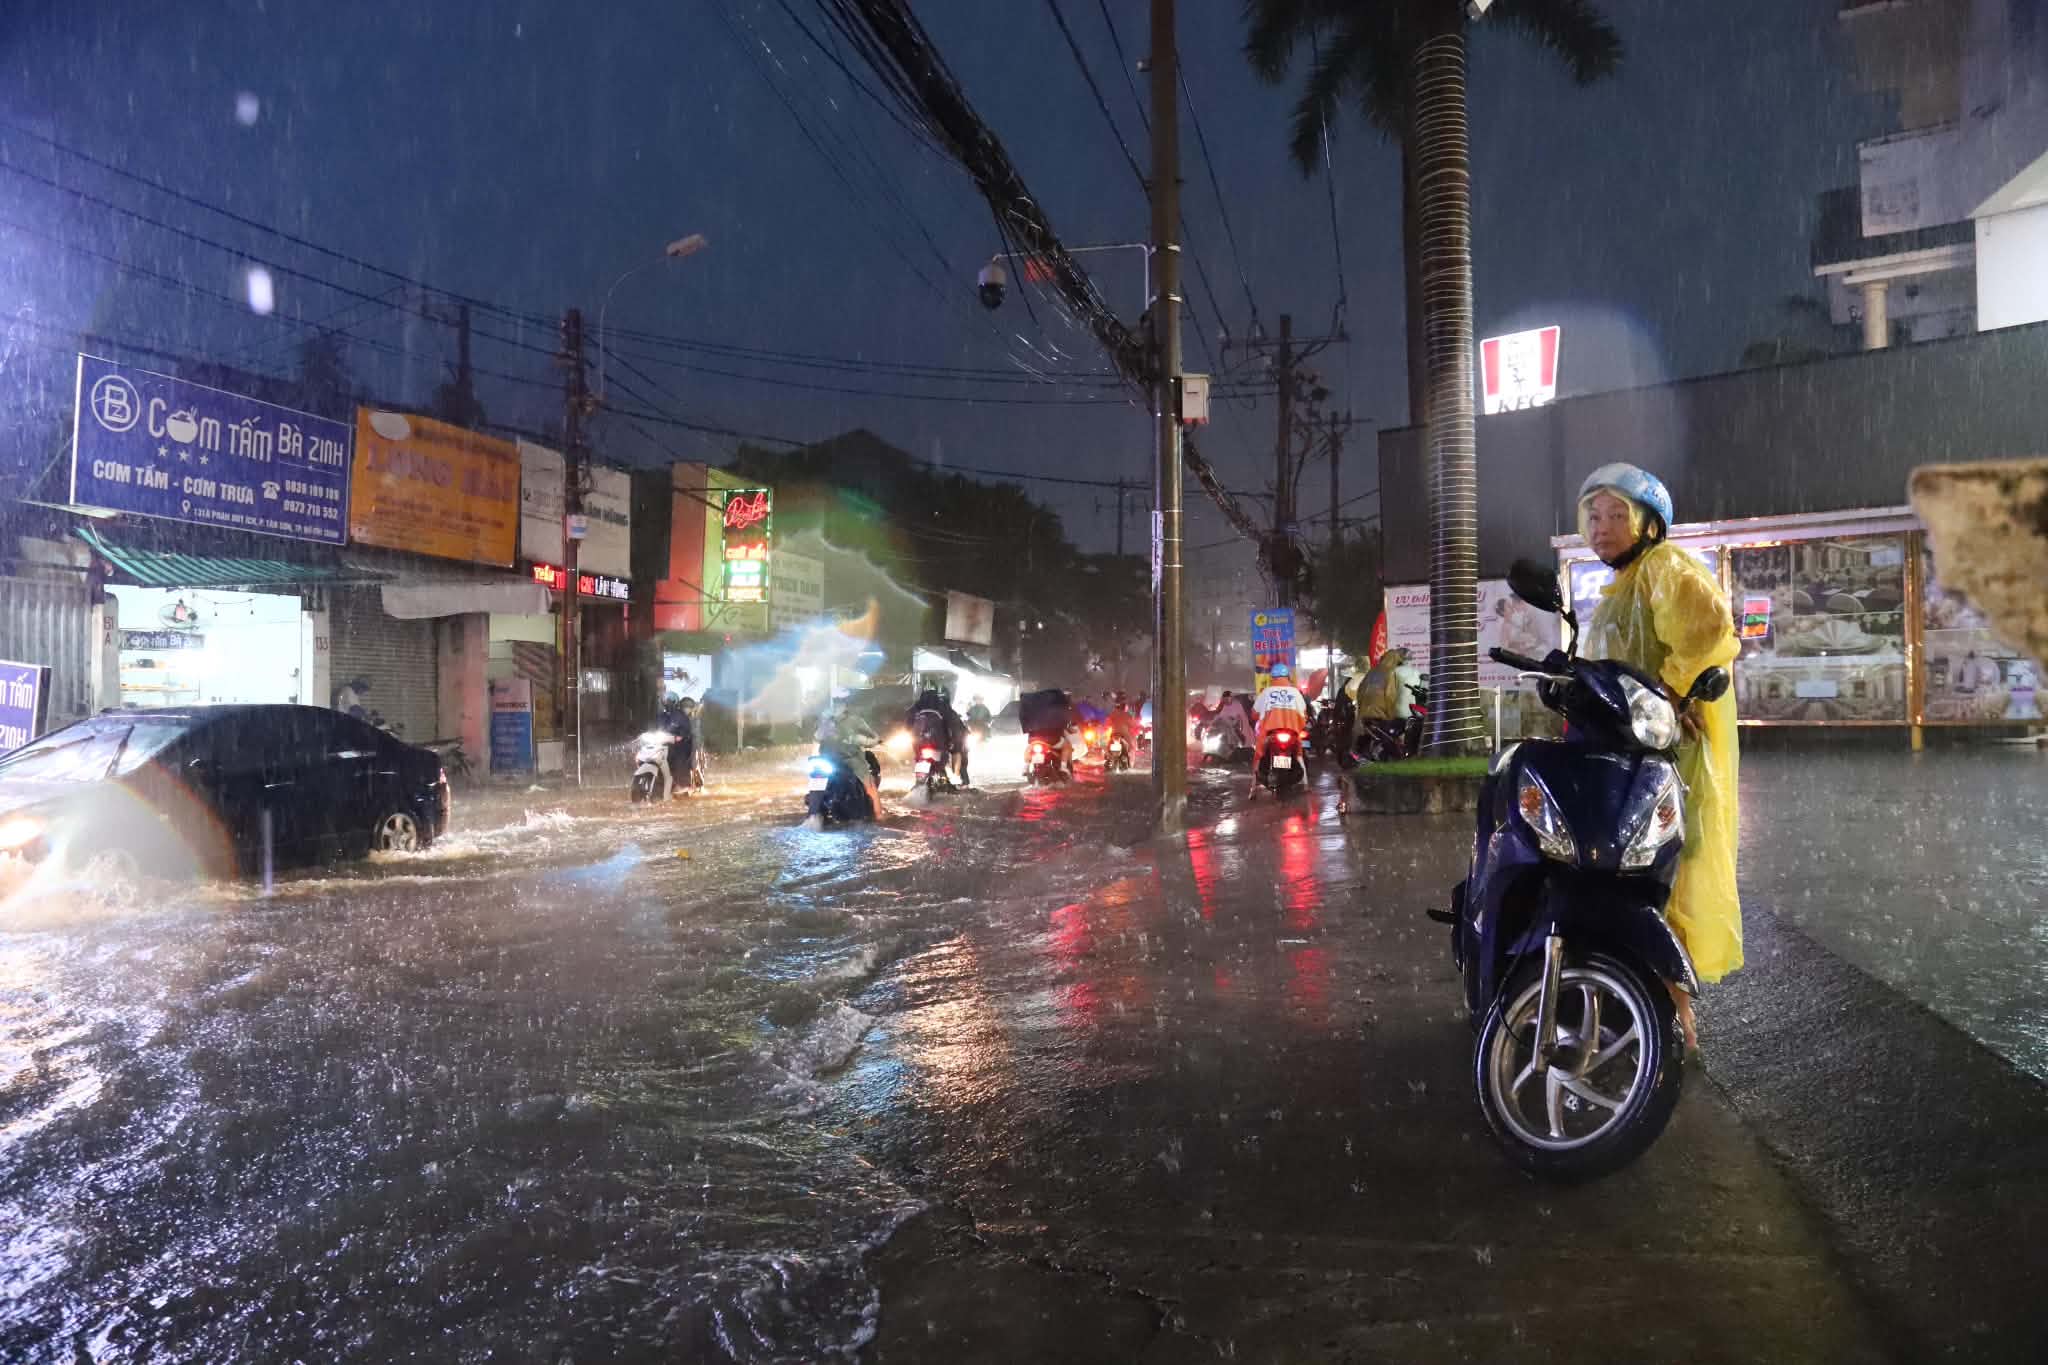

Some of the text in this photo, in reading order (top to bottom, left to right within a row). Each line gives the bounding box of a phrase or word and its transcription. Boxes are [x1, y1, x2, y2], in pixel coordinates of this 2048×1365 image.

[228, 415, 272, 463] TẤM
[278, 421, 303, 458] BÀ
[93, 459, 132, 484] CƠM
[135, 463, 169, 490] TẤM
[183, 475, 217, 499] CƠM
[220, 482, 255, 506] TRƯA
